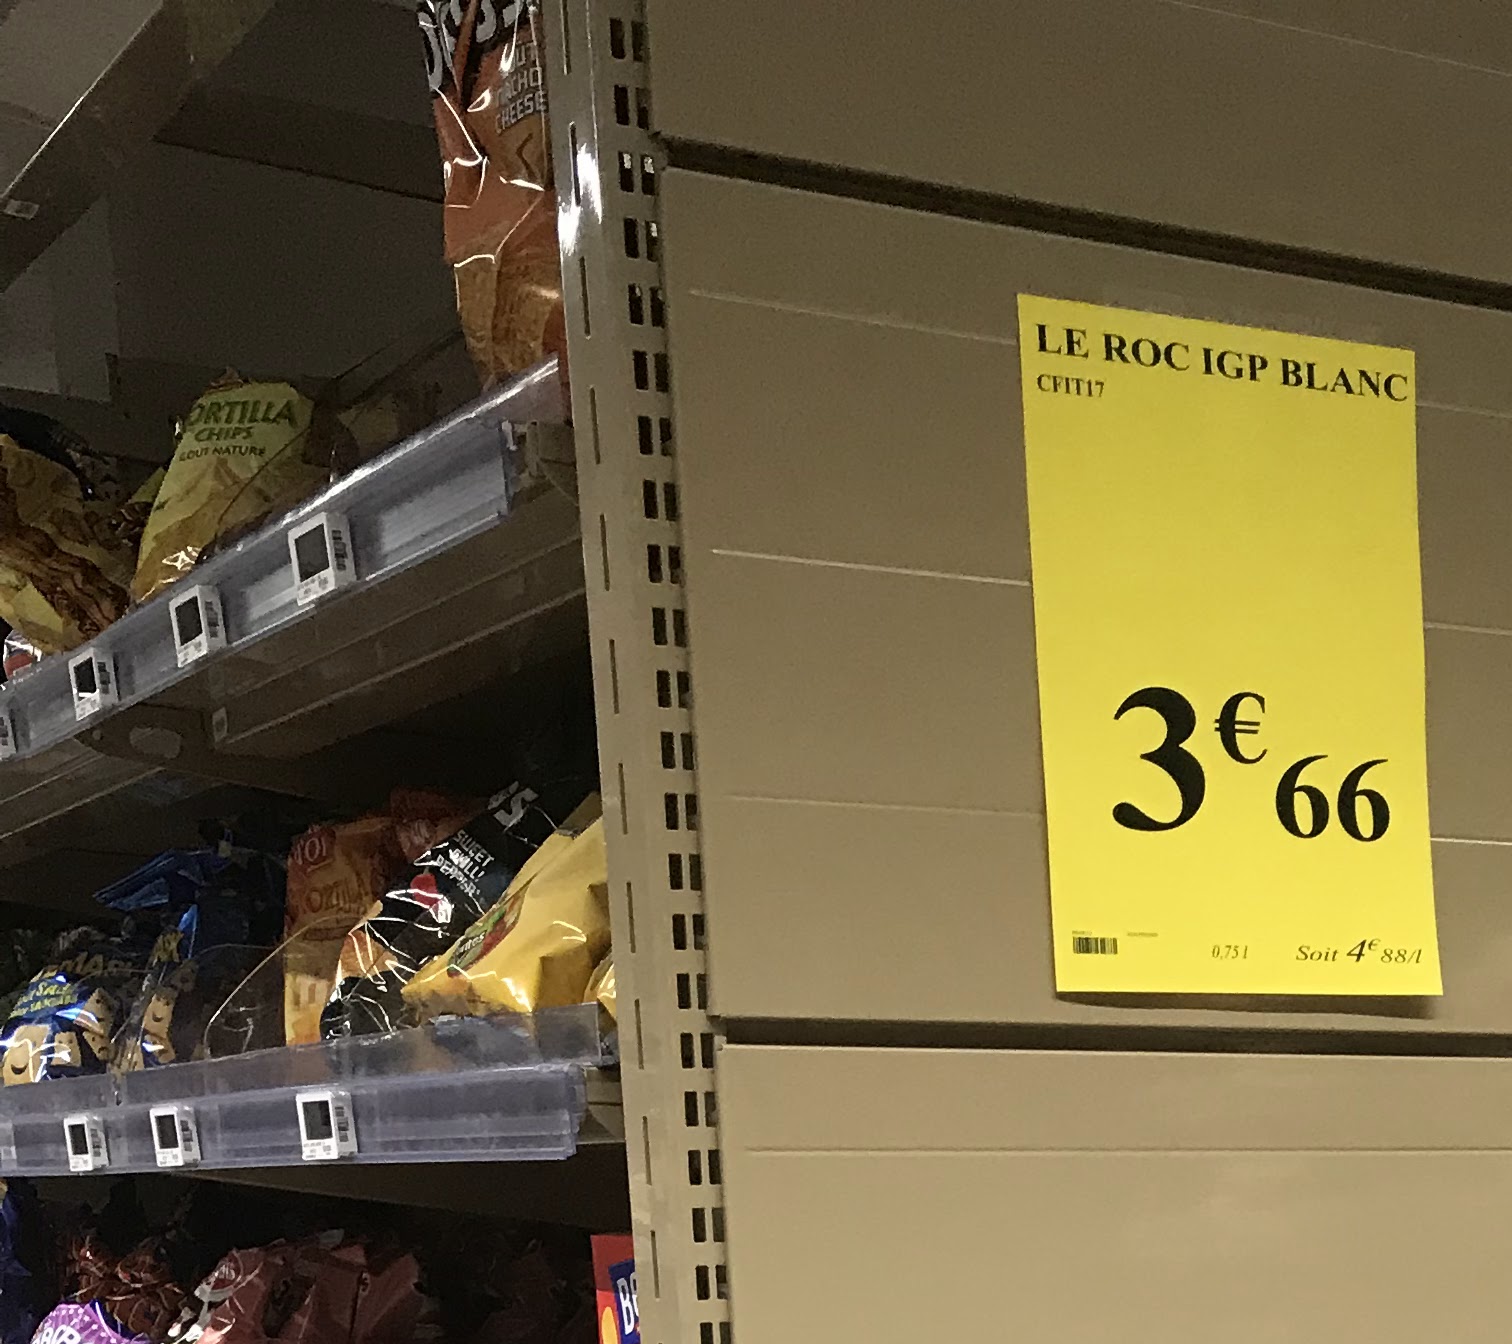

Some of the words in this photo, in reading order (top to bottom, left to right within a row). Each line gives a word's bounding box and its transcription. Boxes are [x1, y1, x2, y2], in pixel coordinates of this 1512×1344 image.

[1036, 324, 1089, 358] LE
[1103, 333, 1190, 371] ROC
[1202, 347, 1268, 382] IGP
[1280, 357, 1408, 402] BLANC
[1036, 373, 1104, 398] CFIT17
[212, 445, 266, 458] NATURE
[452, 829, 495, 868] SWEET
[1296, 945, 1338, 962] Soit
